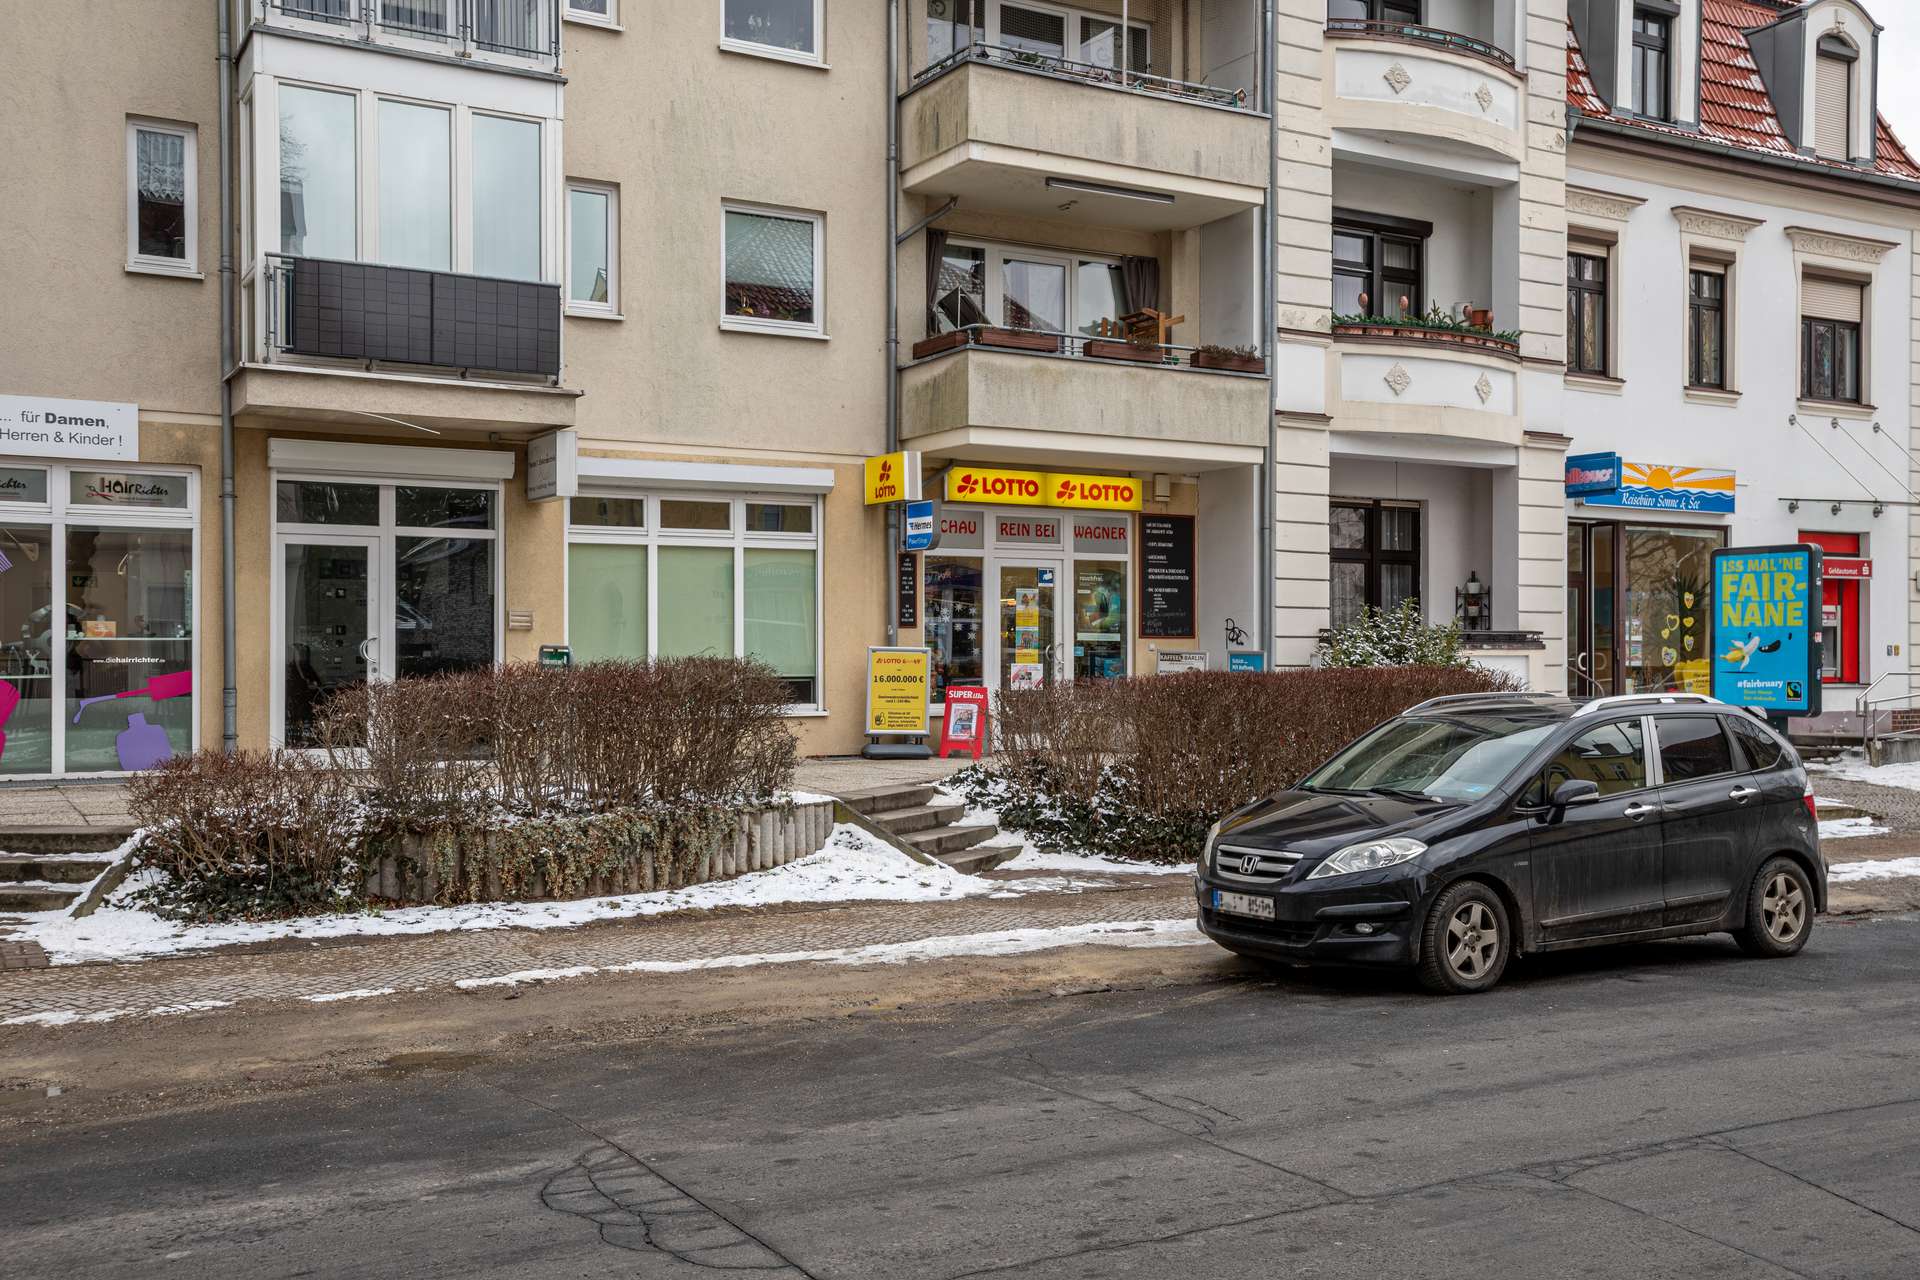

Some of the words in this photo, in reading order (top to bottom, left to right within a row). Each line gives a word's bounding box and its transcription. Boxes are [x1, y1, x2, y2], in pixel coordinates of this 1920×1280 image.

[21, 410, 41, 423] für
[45, 412, 110, 429] Damen,
[0, 428, 49, 442] Herren
[53, 431, 64, 443] &
[69, 432, 115, 446] Kinder
[875, 485, 896, 499] LOTTO
[982, 477, 1039, 497] LOTTO
[1080, 483, 1134, 502] LOTTO
[1621, 492, 1655, 506] Reisebüro
[1688, 496, 1700, 509] See
[911, 521, 932, 531] Hermes
[940, 519, 977, 535] CHAU
[1000, 522, 1030, 537] REIN
[1035, 524, 1055, 538] BEI
[1073, 525, 1127, 541] WAGNER
[1723, 560, 1744, 572] ISS
[1748, 558, 1777, 571] MAL
[1828, 567, 1858, 576] Geldautomat
[1722, 572, 1807, 601] FAIR-
[1722, 601, 1803, 627] NANE
[919, 675, 924, 683] €
[1737, 679, 1783, 688] #fairbruary
